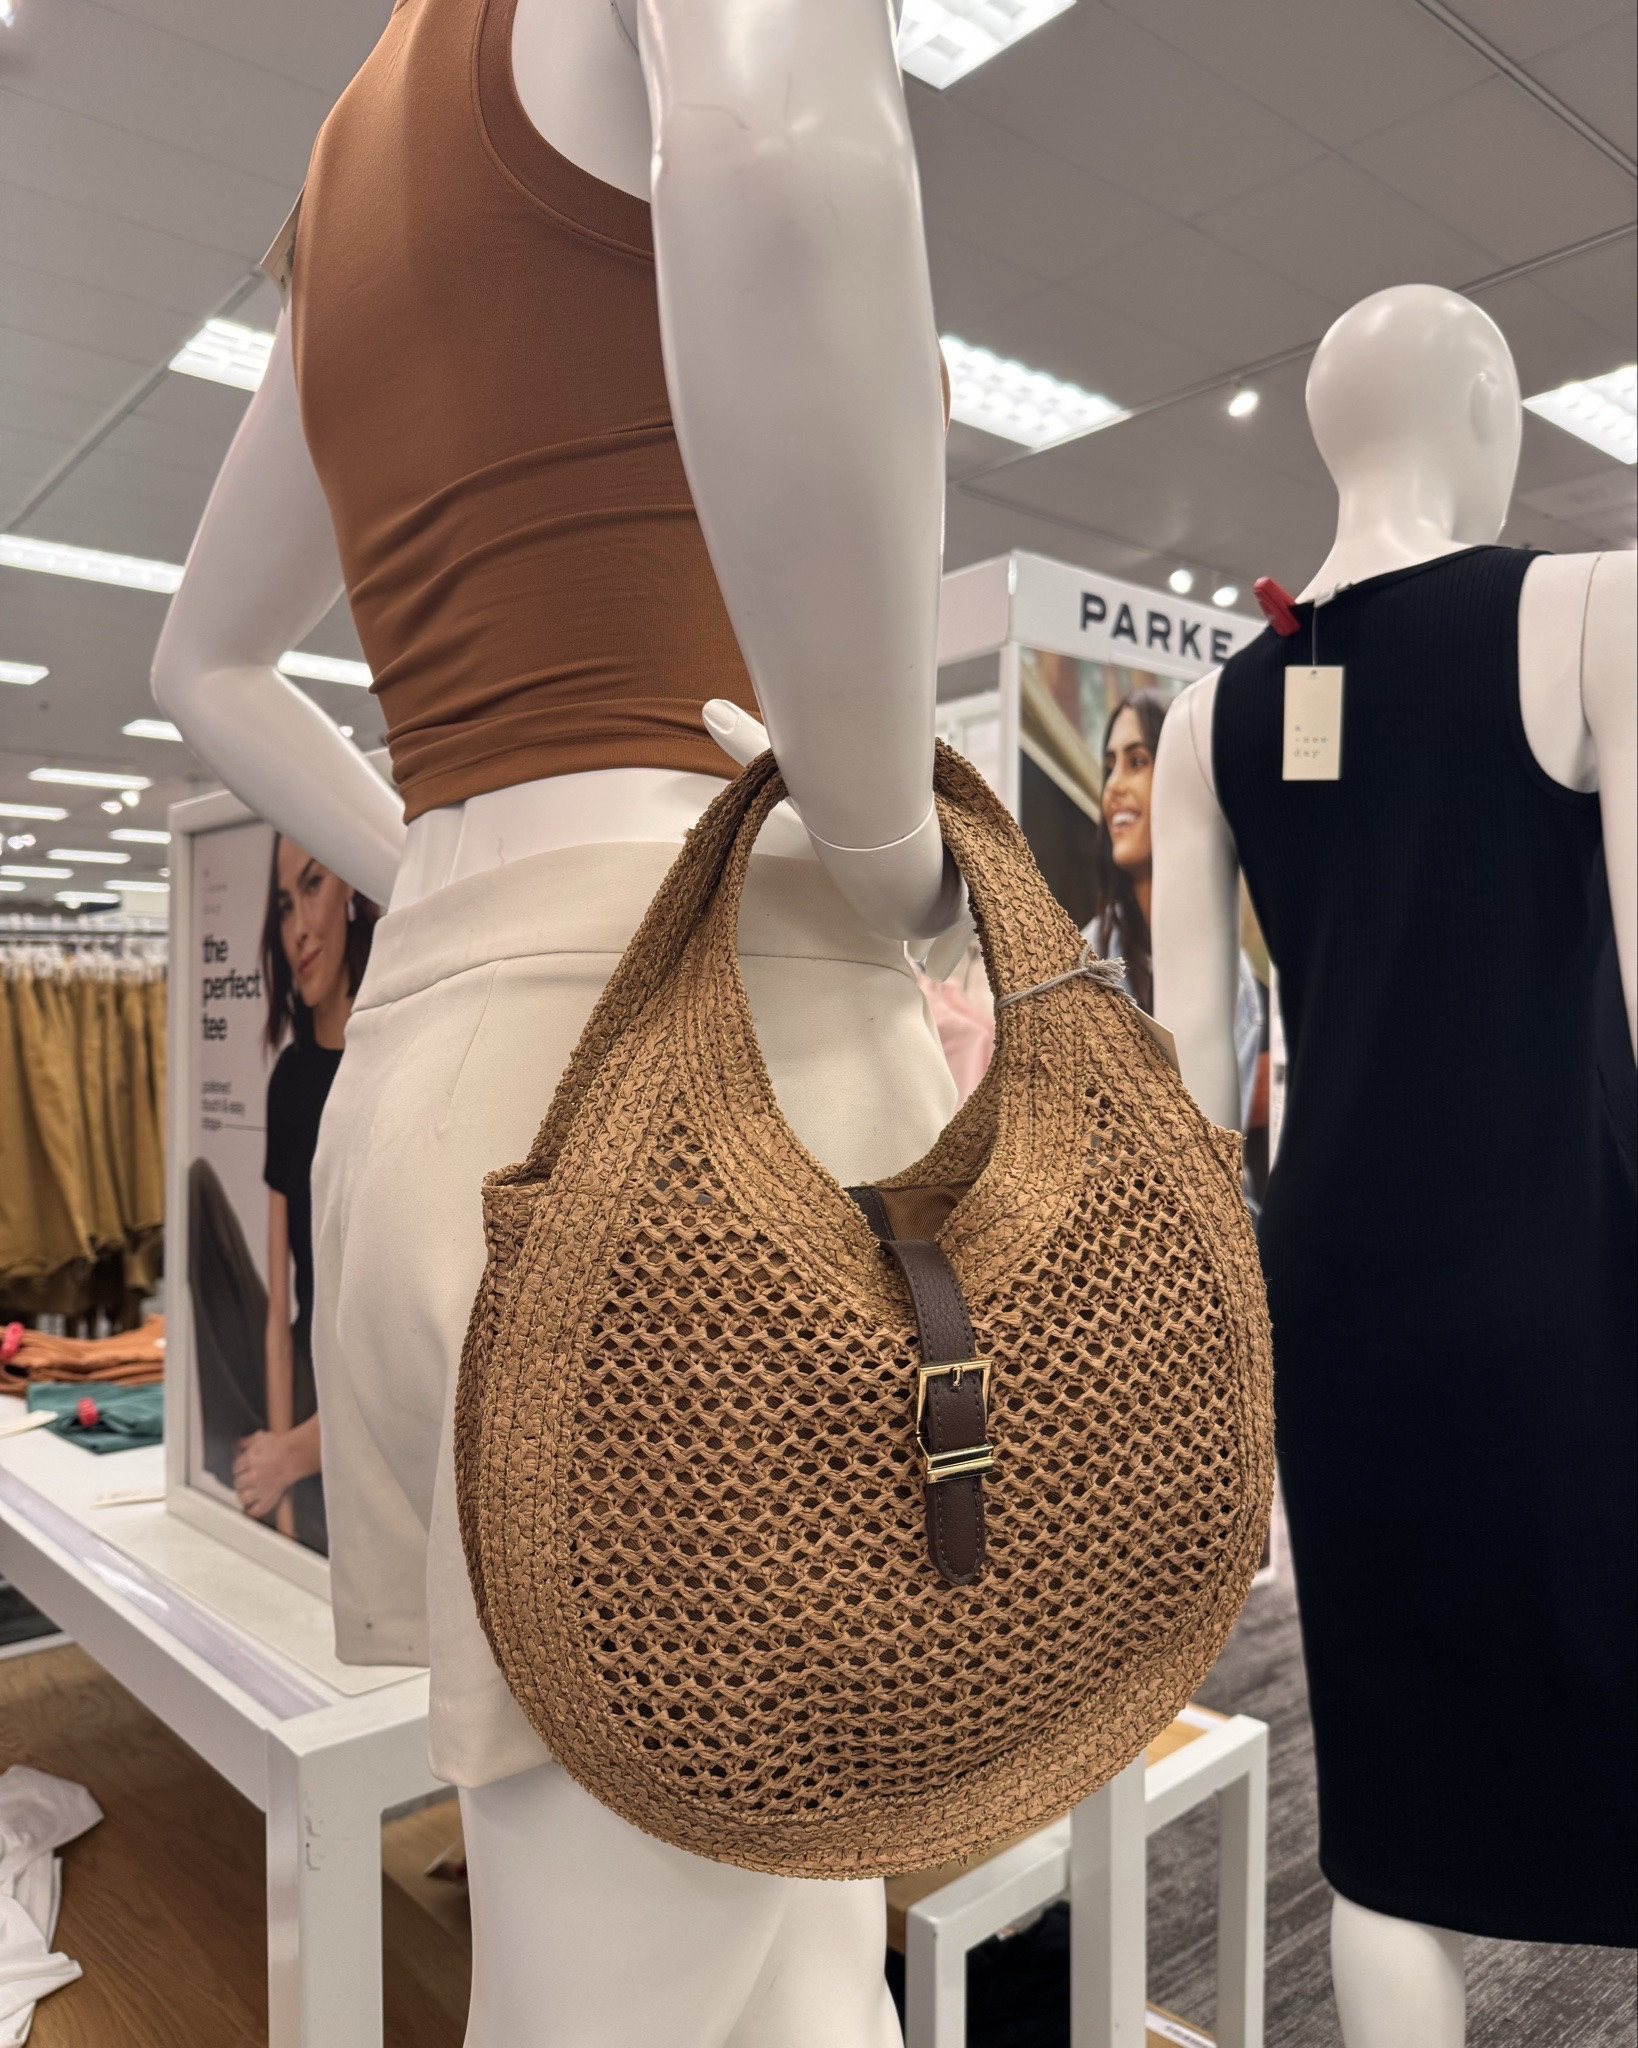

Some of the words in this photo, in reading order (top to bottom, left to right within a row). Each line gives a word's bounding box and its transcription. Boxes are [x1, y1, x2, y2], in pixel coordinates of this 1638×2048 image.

[1080, 592, 1233, 664] PARKE
[203, 933, 229, 963] the
[202, 968, 261, 1008] perfect
[202, 1012, 228, 1041] tee
